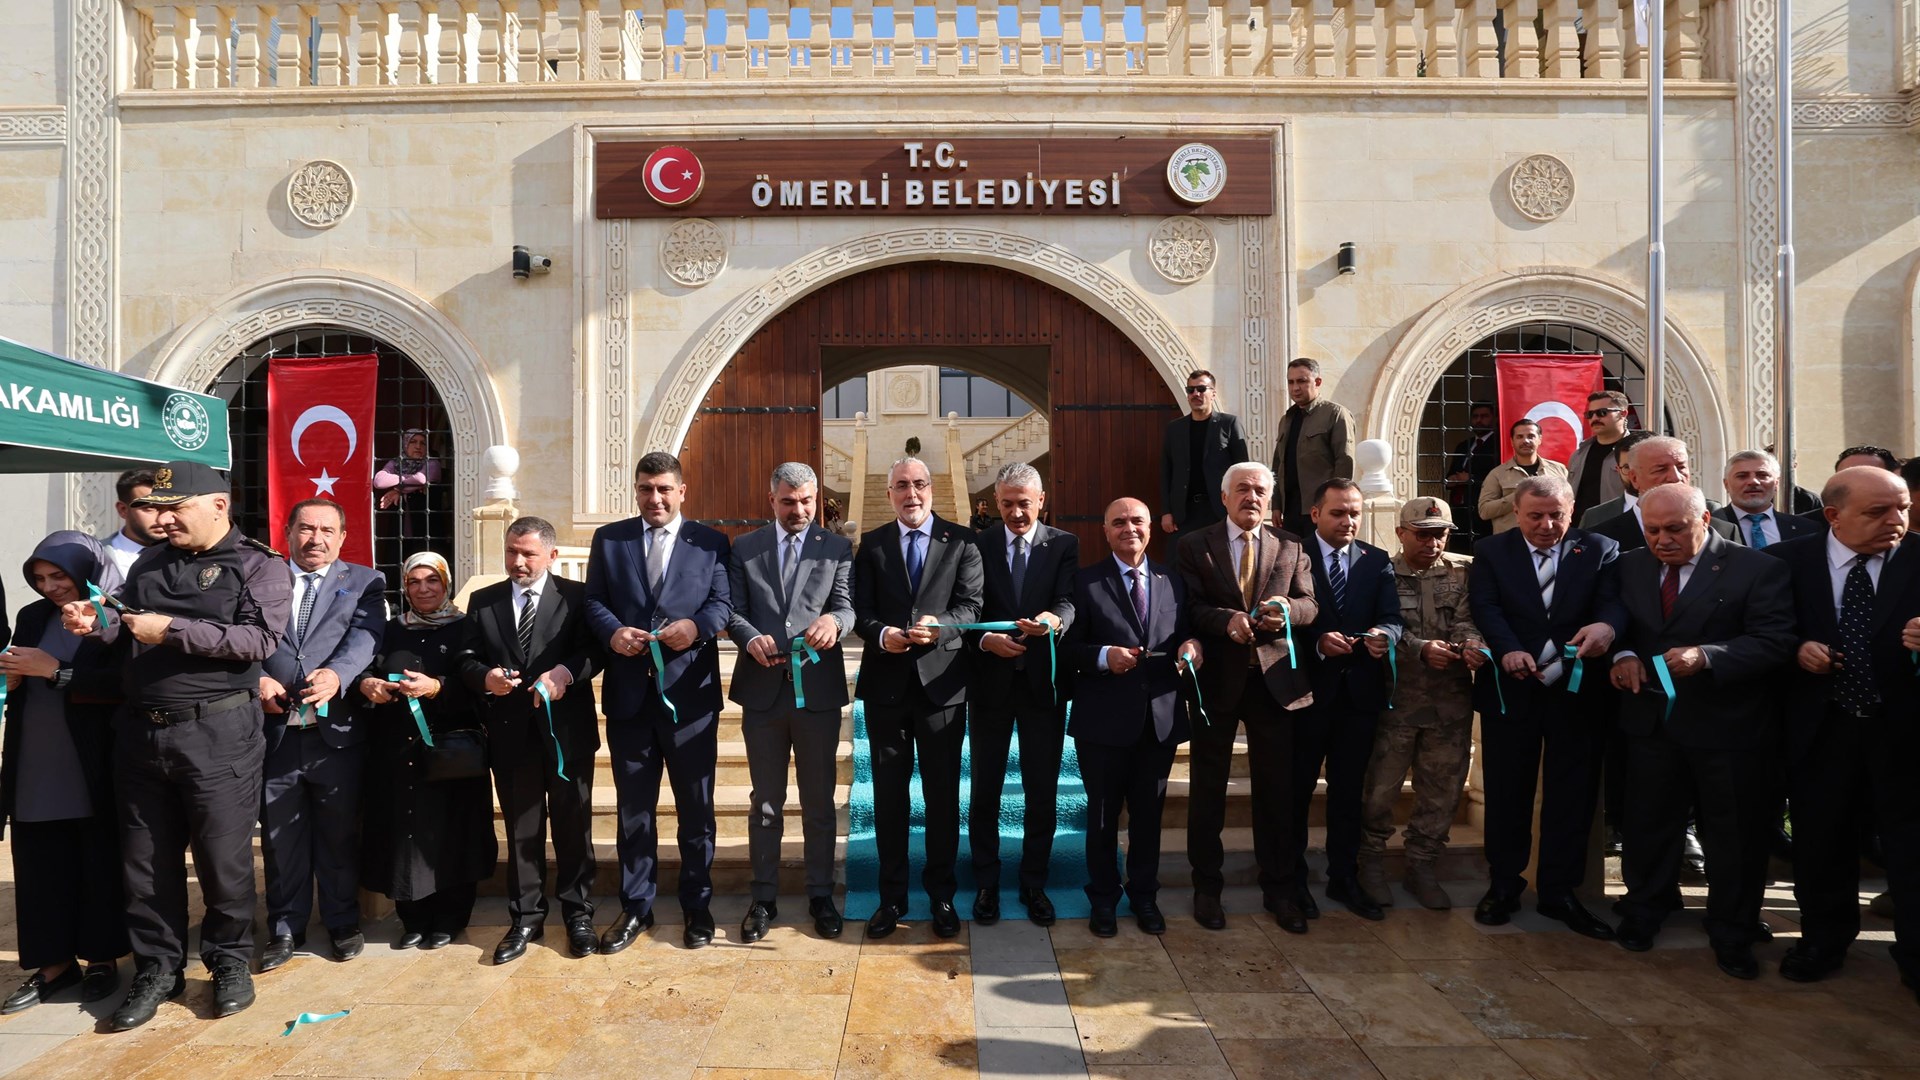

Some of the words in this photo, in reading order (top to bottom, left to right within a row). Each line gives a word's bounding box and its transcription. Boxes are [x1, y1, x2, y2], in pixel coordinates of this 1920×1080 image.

[904, 142, 968, 168] T.C.
[752, 173, 890, 207] ÖMERLİ
[905, 172, 1120, 206] BELEDİYESİ
